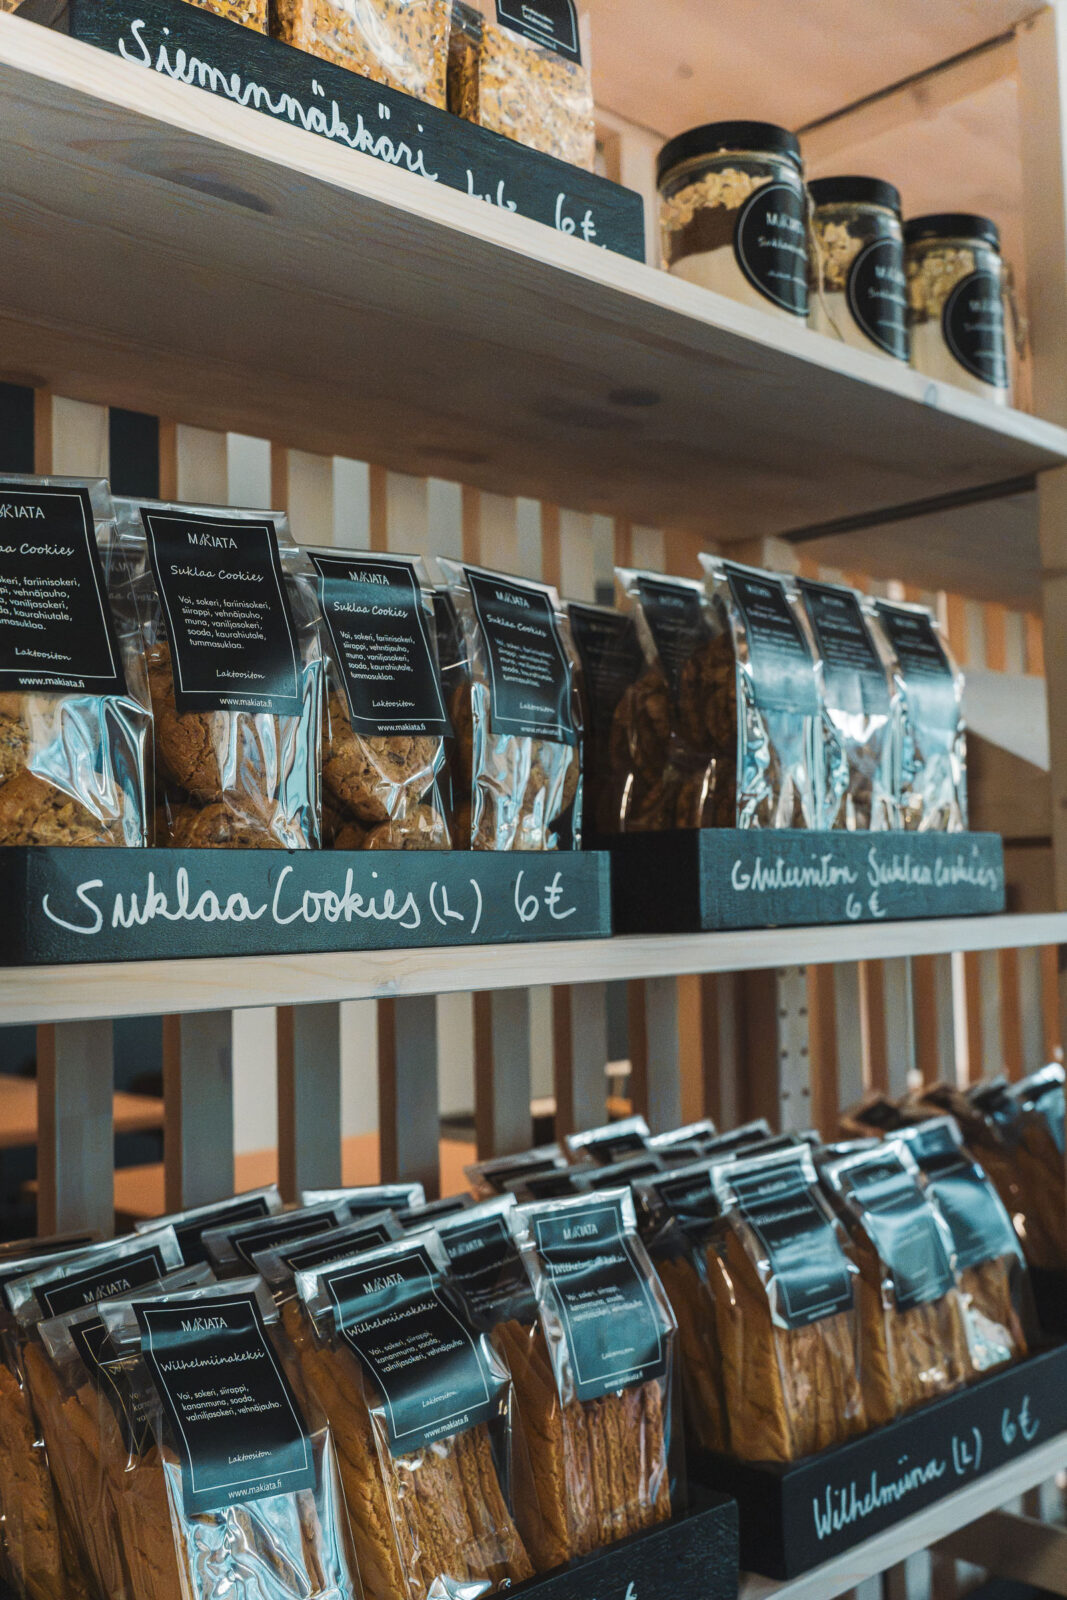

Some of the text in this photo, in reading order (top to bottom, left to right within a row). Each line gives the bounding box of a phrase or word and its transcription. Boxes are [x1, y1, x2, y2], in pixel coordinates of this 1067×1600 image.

[20, 543, 74, 556] Cookies
[170, 564, 264, 583] Suklaa Cookies
[0, 576, 21, 586] keri,
[13, 586, 70, 599] vehnäjauho,
[178, 595, 195, 606] Voi,
[196, 597, 222, 608] sokeri,
[14, 607, 73, 622] kaurahiutale,
[182, 606, 263, 620] siirappi, vehnäjauho,
[333, 601, 408, 618] Suklaa Cookies
[185, 617, 210, 627] muna,
[187, 627, 267, 641] sooda, kaurahiutale,
[19, 676, 85, 688] www.makiata.fi
[219, 698, 272, 708] www.makiata.fi
[42, 867, 268, 935] Suklaa
[272, 865, 420, 929] Cookies
[429, 880, 482, 934] (L)
[160, 1348, 265, 1372] Wilhelmiinakeksi
[194, 1388, 219, 1399] sokeri,
[181, 1394, 255, 1411] kananmuna, sooda,
[951, 1426, 983, 1475] (L)
[228, 1479, 282, 1499] www.makiata.fi
